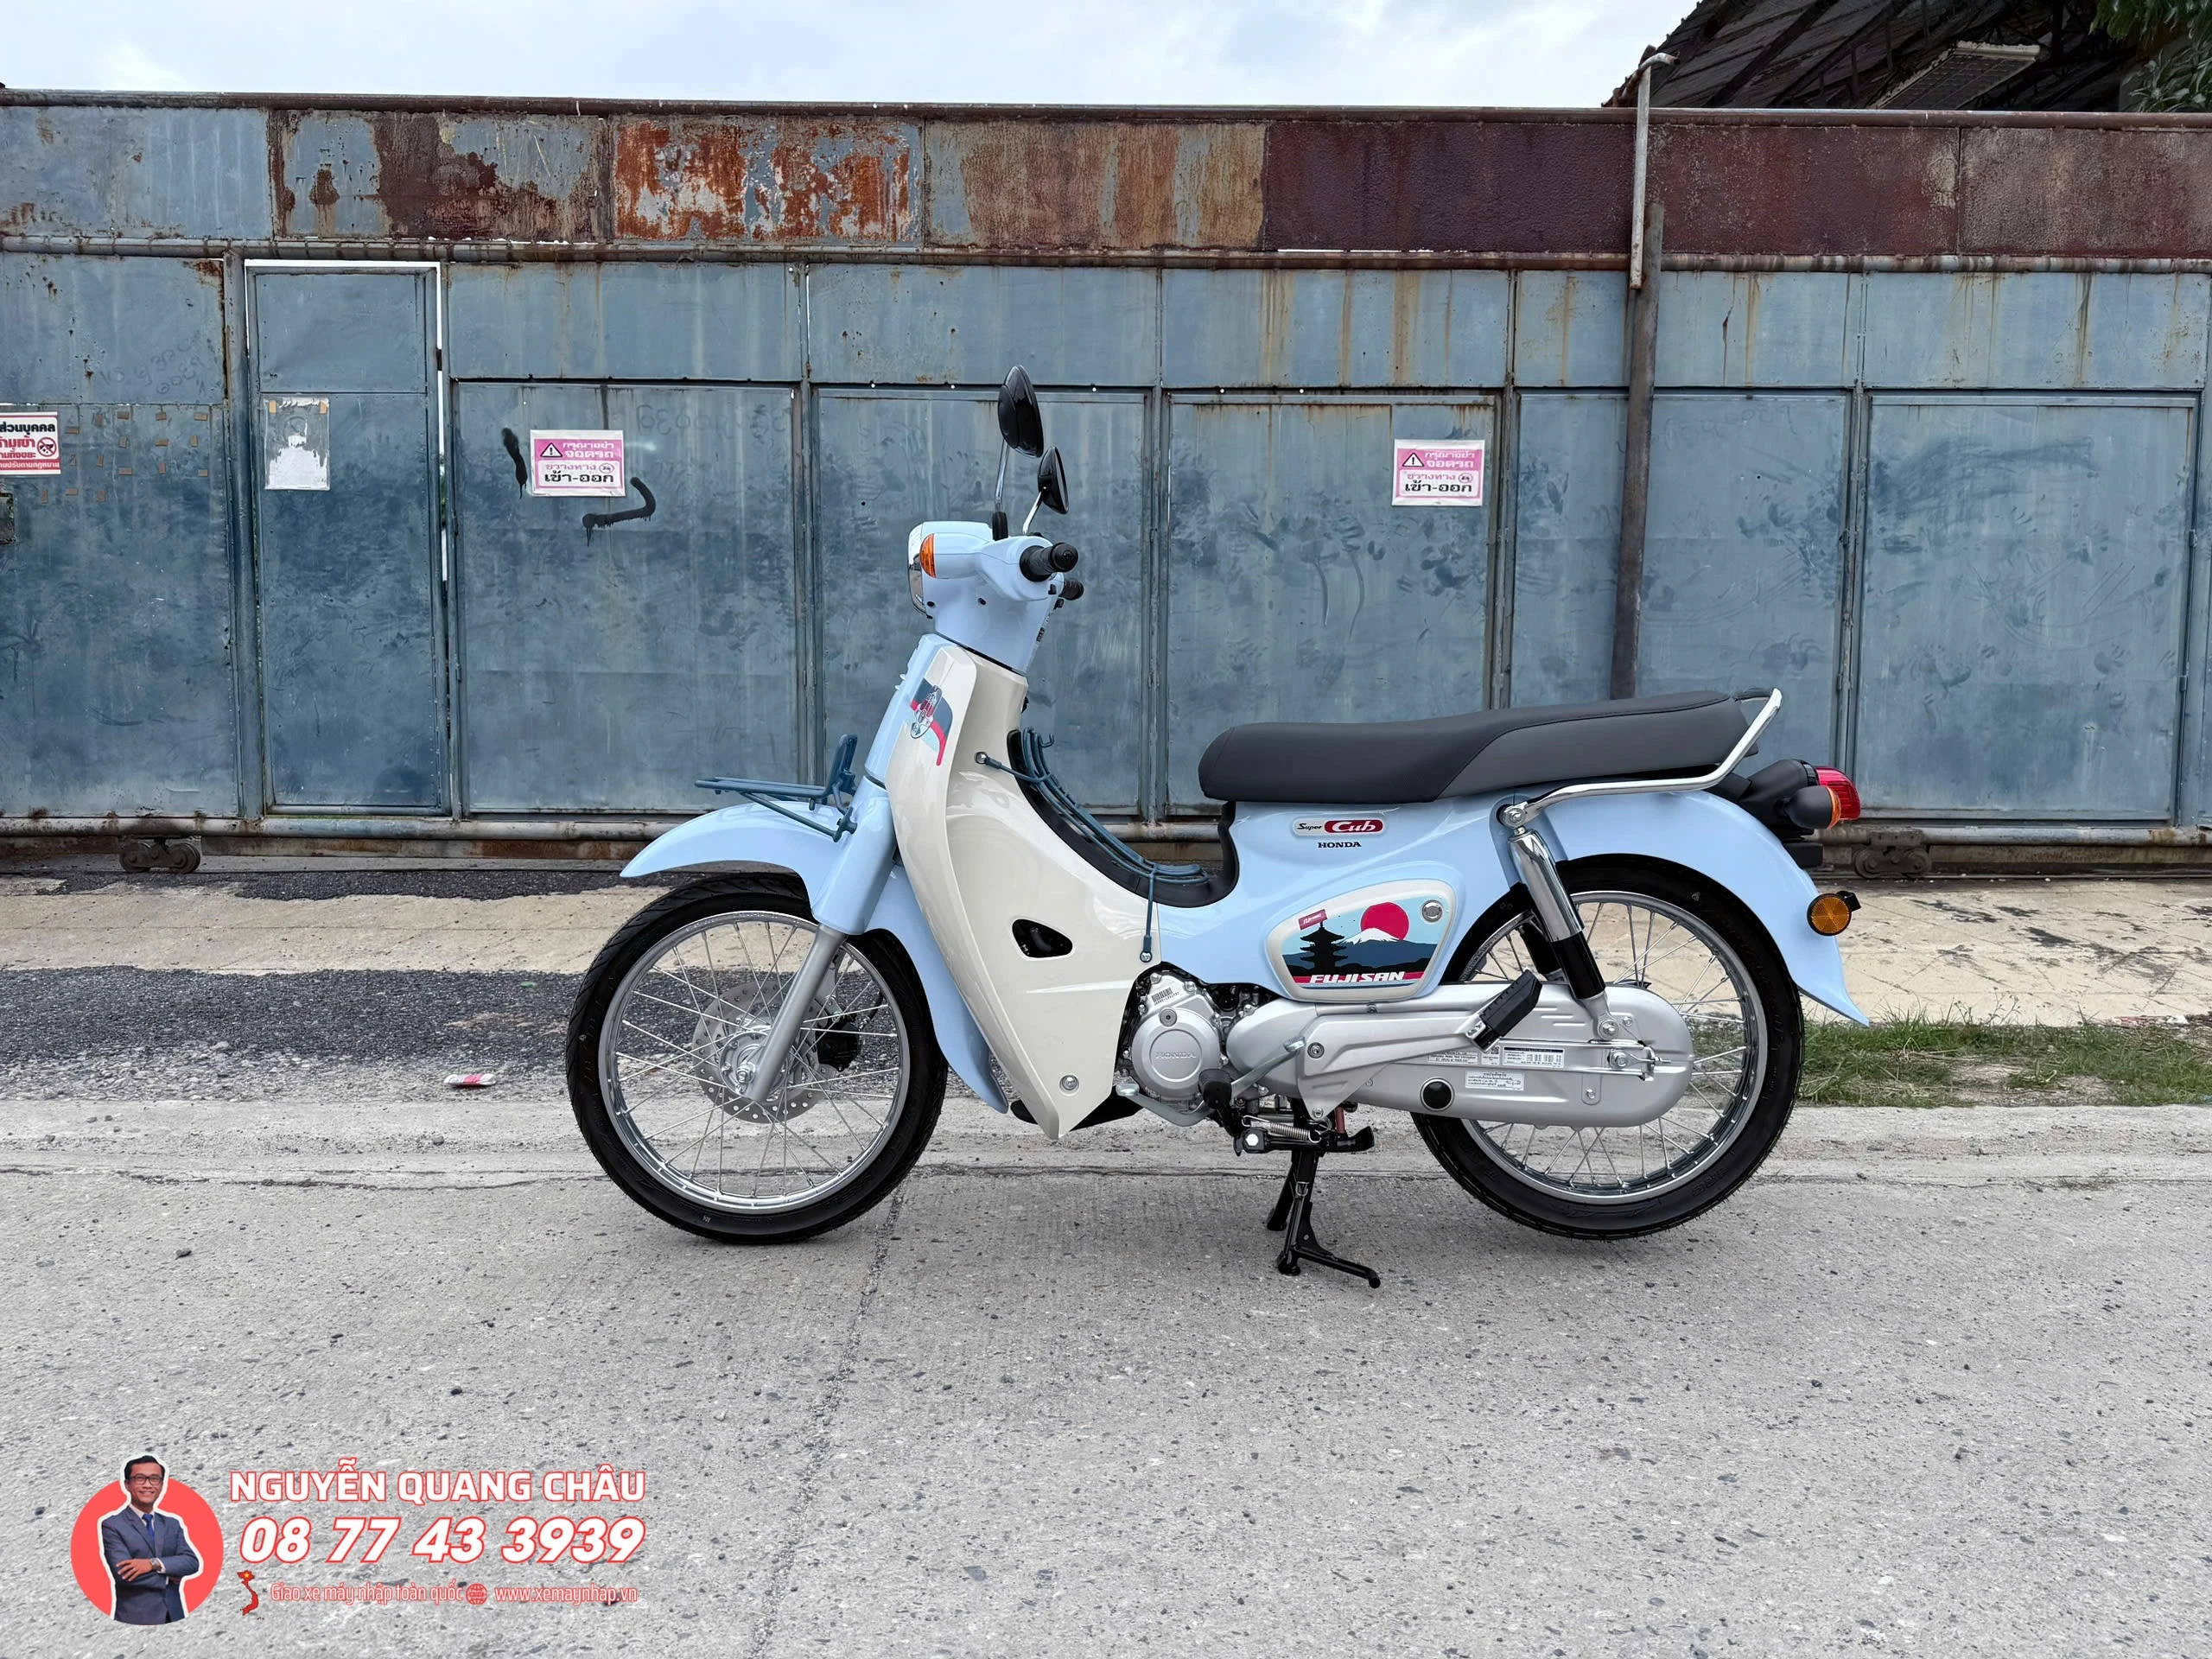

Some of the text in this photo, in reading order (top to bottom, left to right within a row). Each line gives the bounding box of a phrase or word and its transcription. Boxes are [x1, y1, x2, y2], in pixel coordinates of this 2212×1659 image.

[564, 450, 614, 459] จอดรถ
[1426, 460, 1474, 468] จอดรถ
[544, 470, 613, 483] เข้า-ออก
[1405, 480, 1472, 493] เข้า-ออก
[1297, 820, 1376, 832] Super Cub
[1309, 971, 1406, 984] FUJISAN
